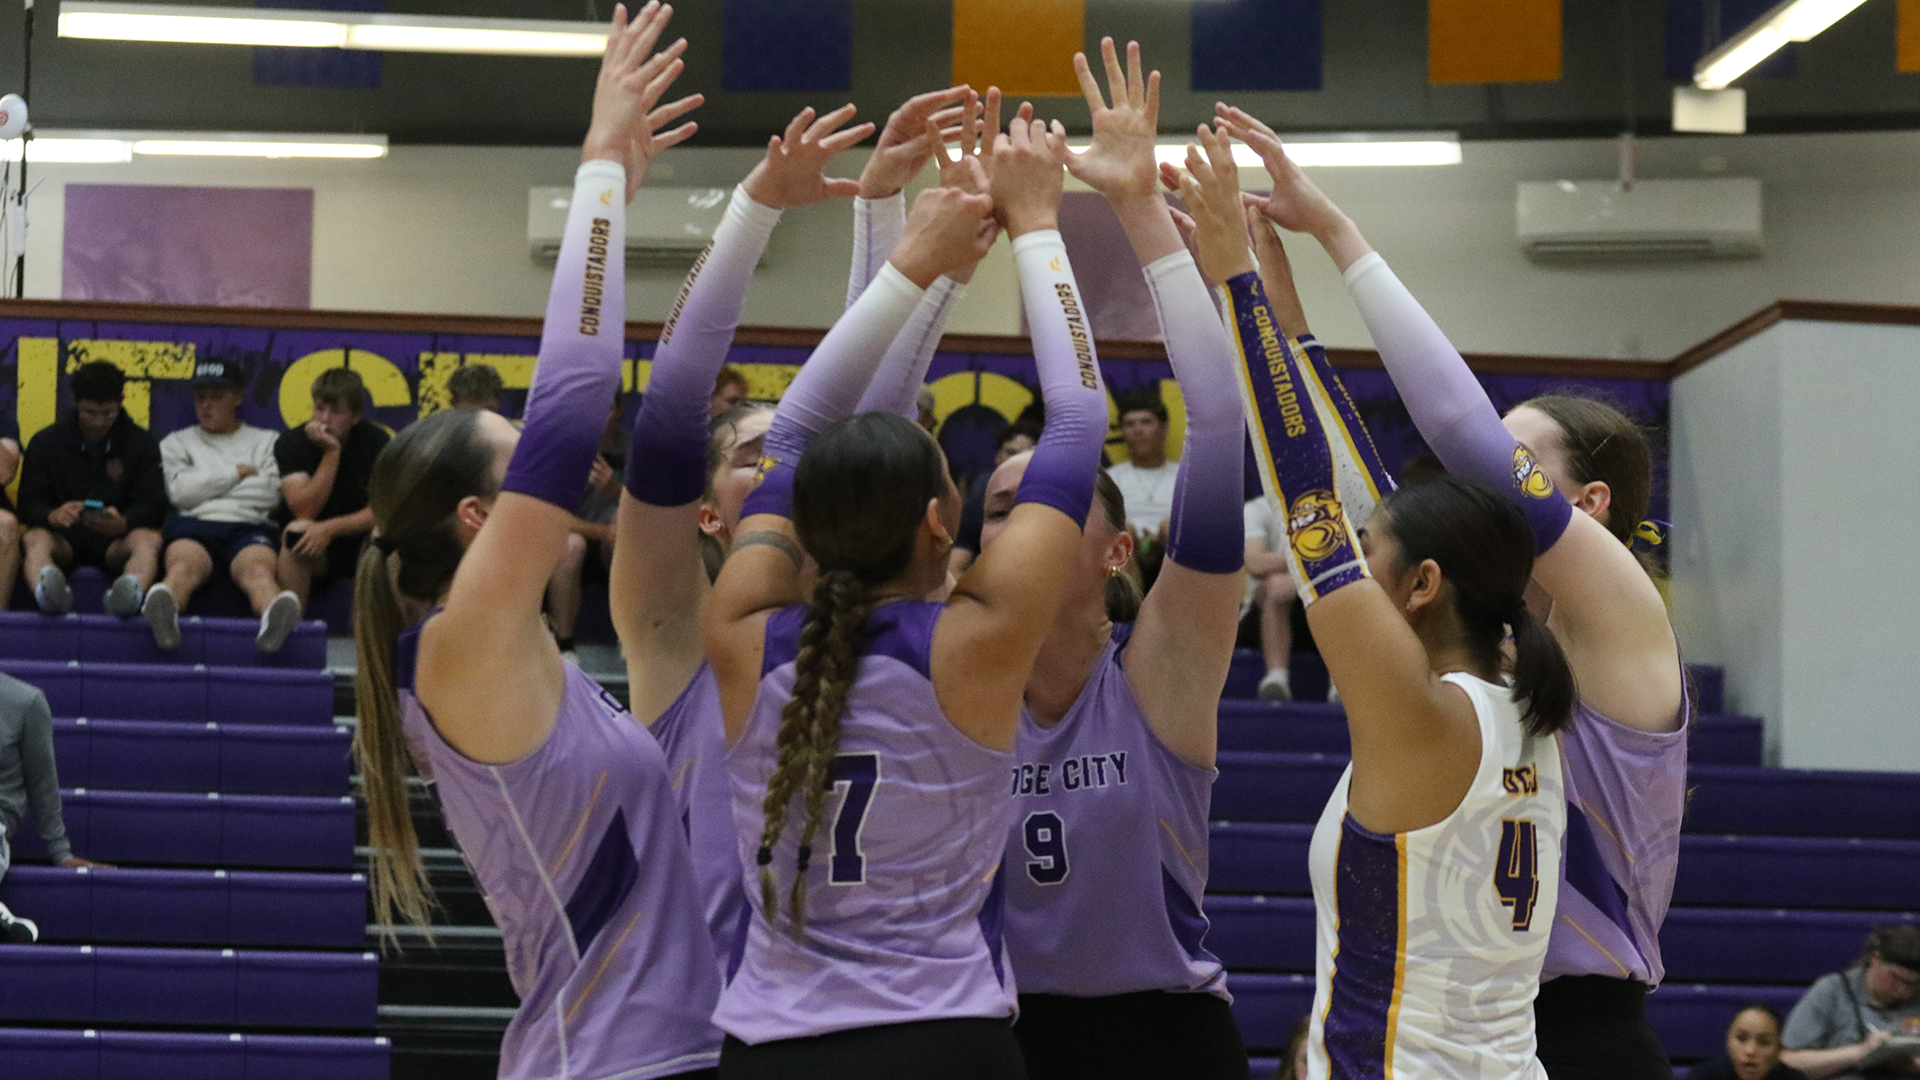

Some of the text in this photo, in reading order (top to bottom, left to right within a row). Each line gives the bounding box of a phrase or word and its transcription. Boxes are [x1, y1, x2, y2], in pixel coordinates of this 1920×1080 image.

[579, 217, 611, 336] CONQUISTADORS
[1055, 281, 1099, 391] CONQUISTADORS
[1251, 304, 1306, 440] CONQUISTADORS
[823, 750, 882, 887] 7
[1061, 750, 1128, 792] CITY
[1022, 809, 1070, 887] 9
[1492, 817, 1540, 932] 4
